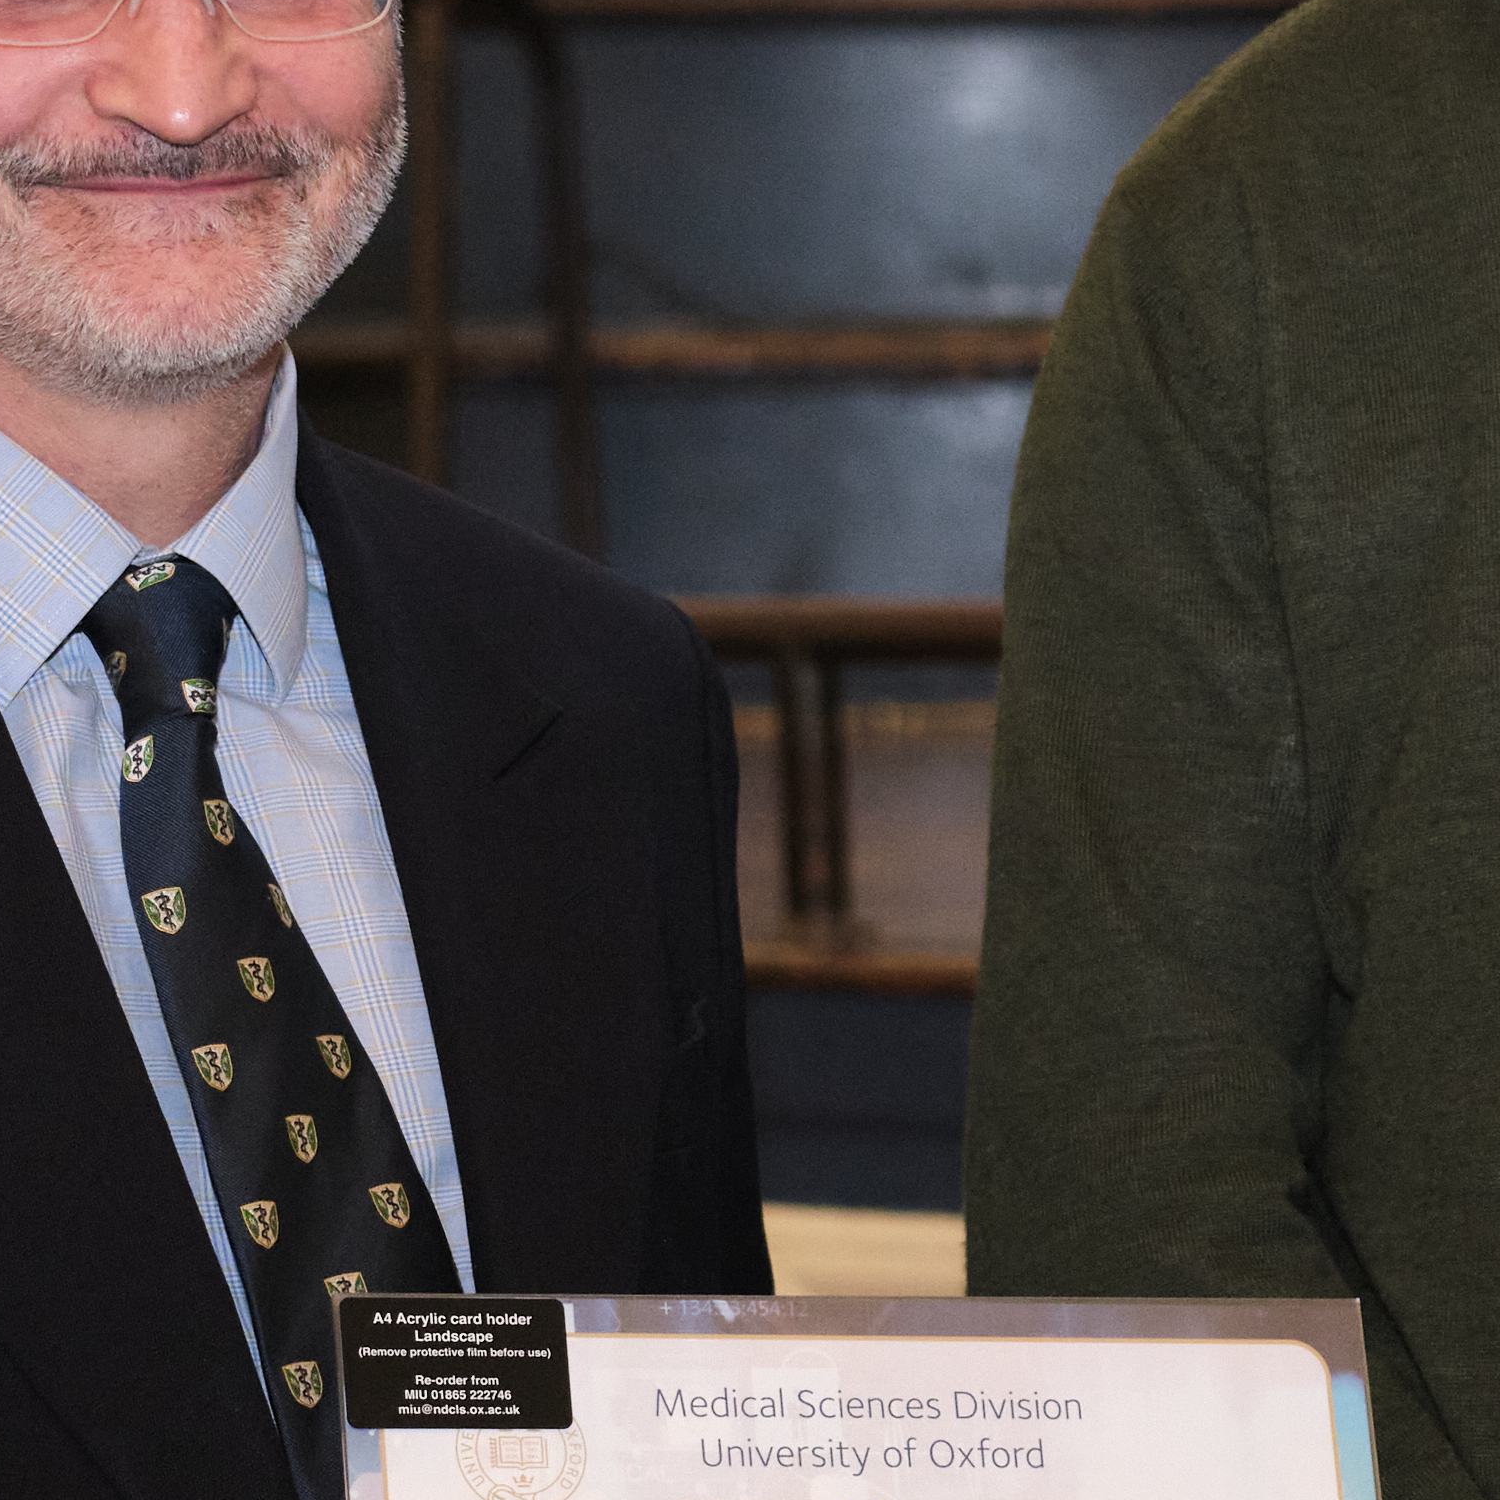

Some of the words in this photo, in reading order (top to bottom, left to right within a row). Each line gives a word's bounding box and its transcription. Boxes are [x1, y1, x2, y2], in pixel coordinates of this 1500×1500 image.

[373, 1313, 392, 1324] A4
[396, 1313, 447, 1327] Acrylic
[450, 1313, 482, 1325] card
[487, 1314, 532, 1325] holder
[415, 1330, 493, 1344] Landscape
[358, 1347, 407, 1358] (Remove
[410, 1348, 464, 1358] protective
[467, 1348, 487, 1357] film
[490, 1348, 524, 1358] before
[527, 1349, 551, 1359] use)
[415, 1375, 468, 1385] Re-order
[471, 1376, 499, 1385] from
[405, 1390, 427, 1400] MIU
[431, 1390, 466, 1400] 01865
[470, 1390, 511, 1400] 222746
[398, 1405, 520, 1415] miu@ndcls.ox.ac.uk
[655, 1387, 785, 1418] Medical
[798, 1390, 941, 1419] Sciences
[954, 1390, 1082, 1420] Division
[700, 1438, 870, 1476] University
[883, 1437, 917, 1468] of
[929, 1438, 1045, 1469] Oxford
